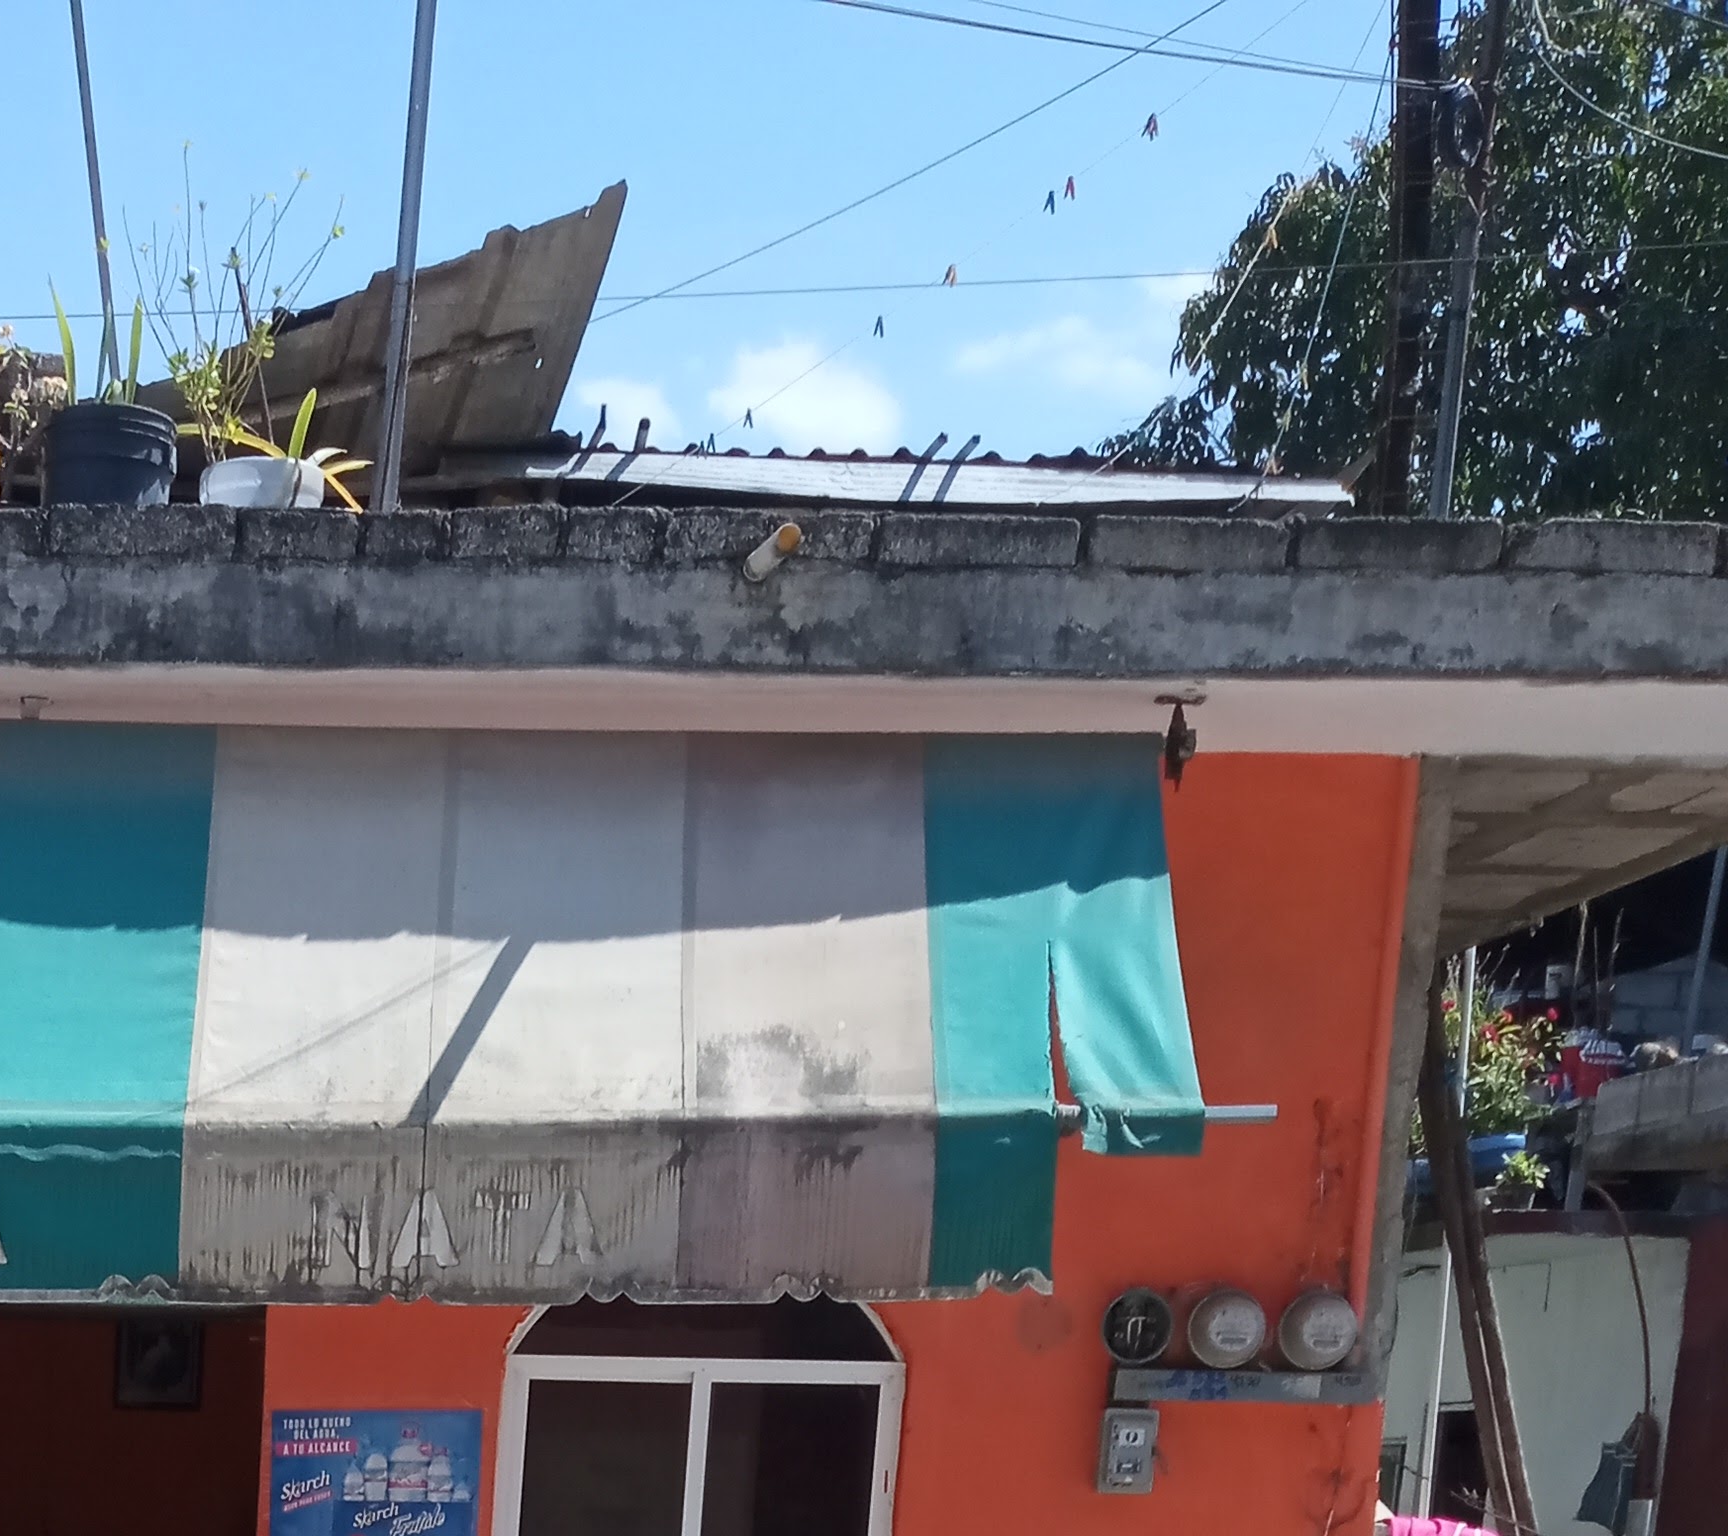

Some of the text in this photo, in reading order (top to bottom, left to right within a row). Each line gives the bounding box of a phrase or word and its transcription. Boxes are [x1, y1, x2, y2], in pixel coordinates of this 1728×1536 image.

[283, 1418, 305, 1430] TODO
[322, 1416, 351, 1428] BUENO
[283, 1440, 350, 1456] A TU ALCANCE
[280, 1470, 331, 1501] Skarch
[352, 1502, 400, 1529] Skarch
